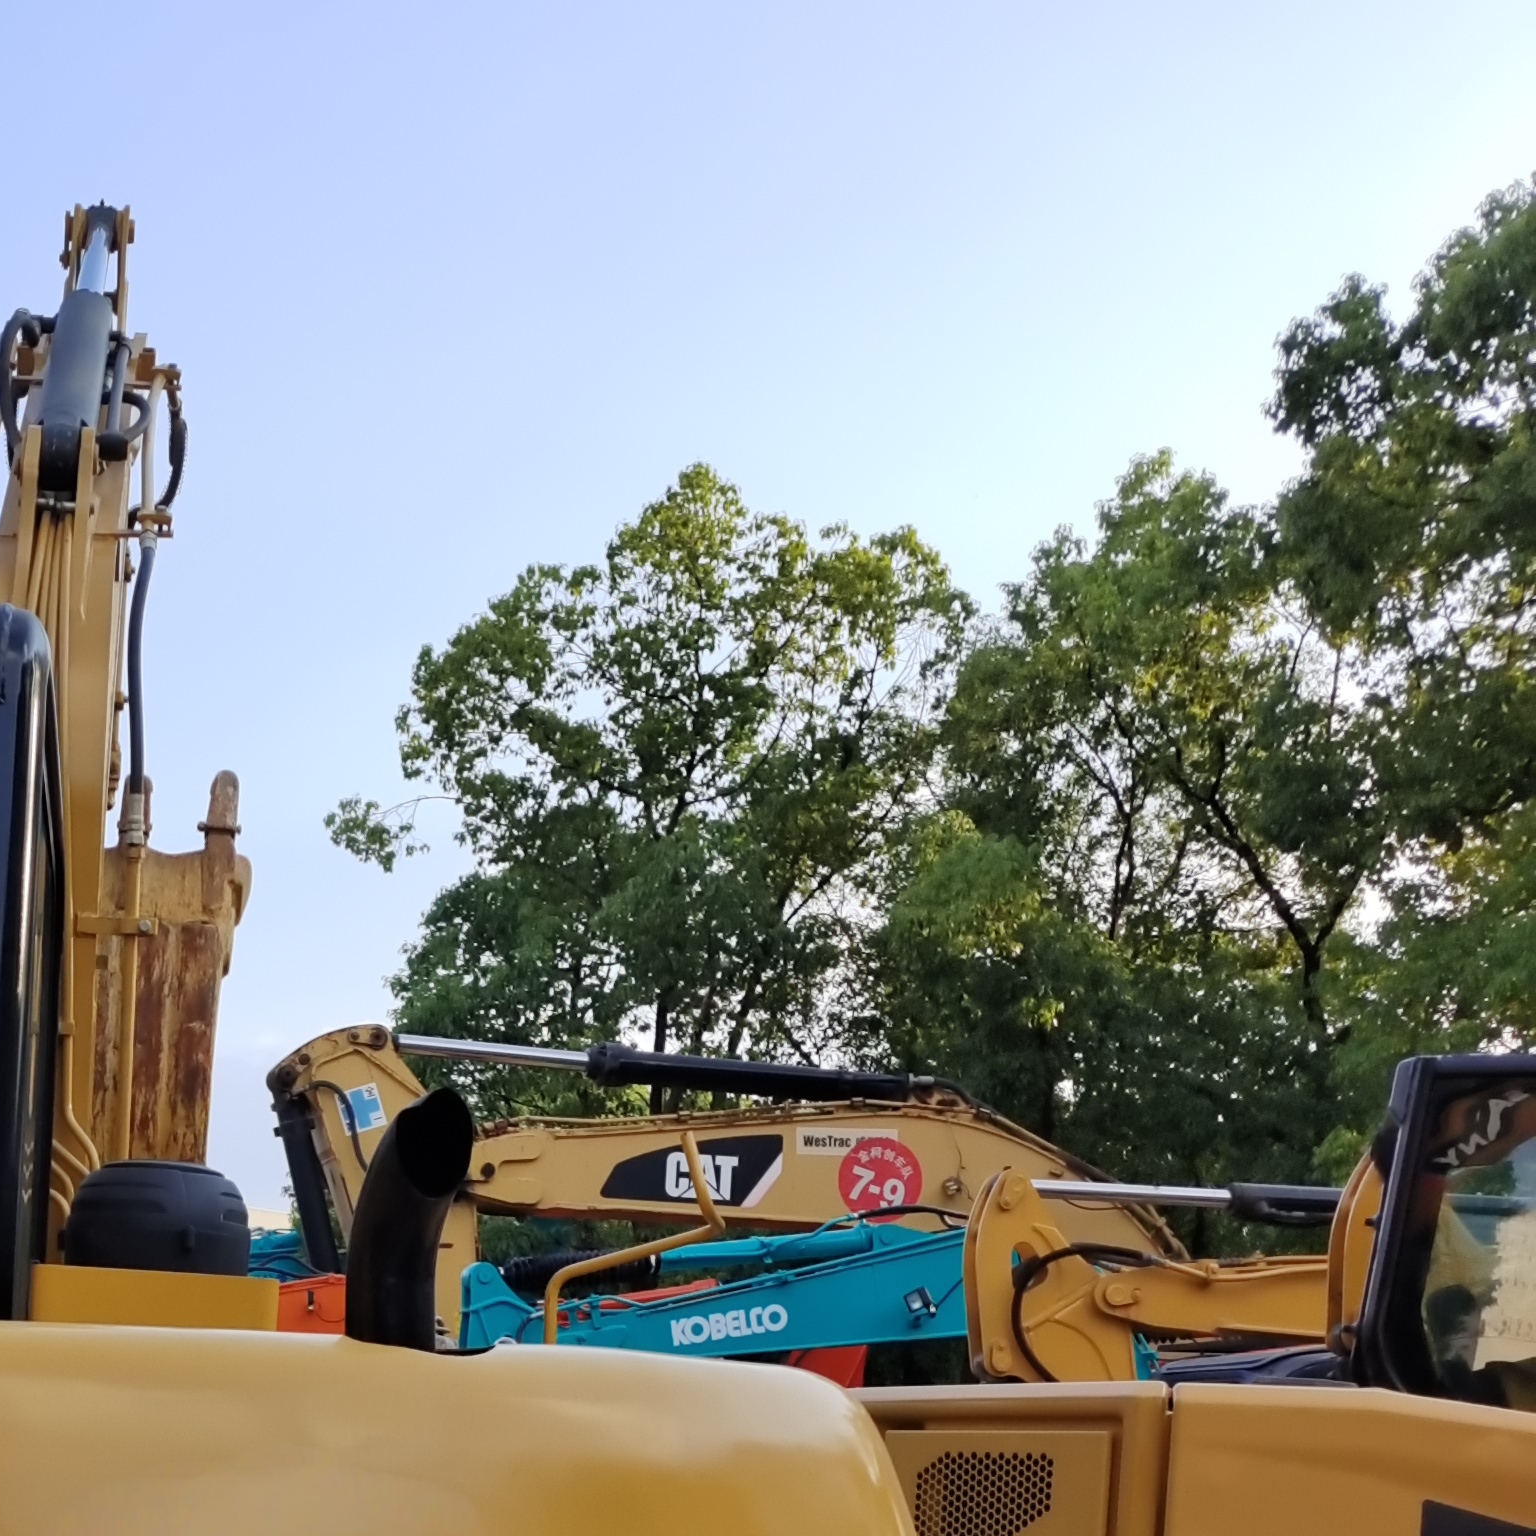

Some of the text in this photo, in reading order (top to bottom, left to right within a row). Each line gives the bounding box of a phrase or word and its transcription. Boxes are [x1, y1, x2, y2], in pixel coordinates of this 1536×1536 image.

[803, 1135, 851, 1148] WesTrac
[849, 1165, 906, 1208] 7-9
[670, 1304, 788, 1347] KOBELCO
